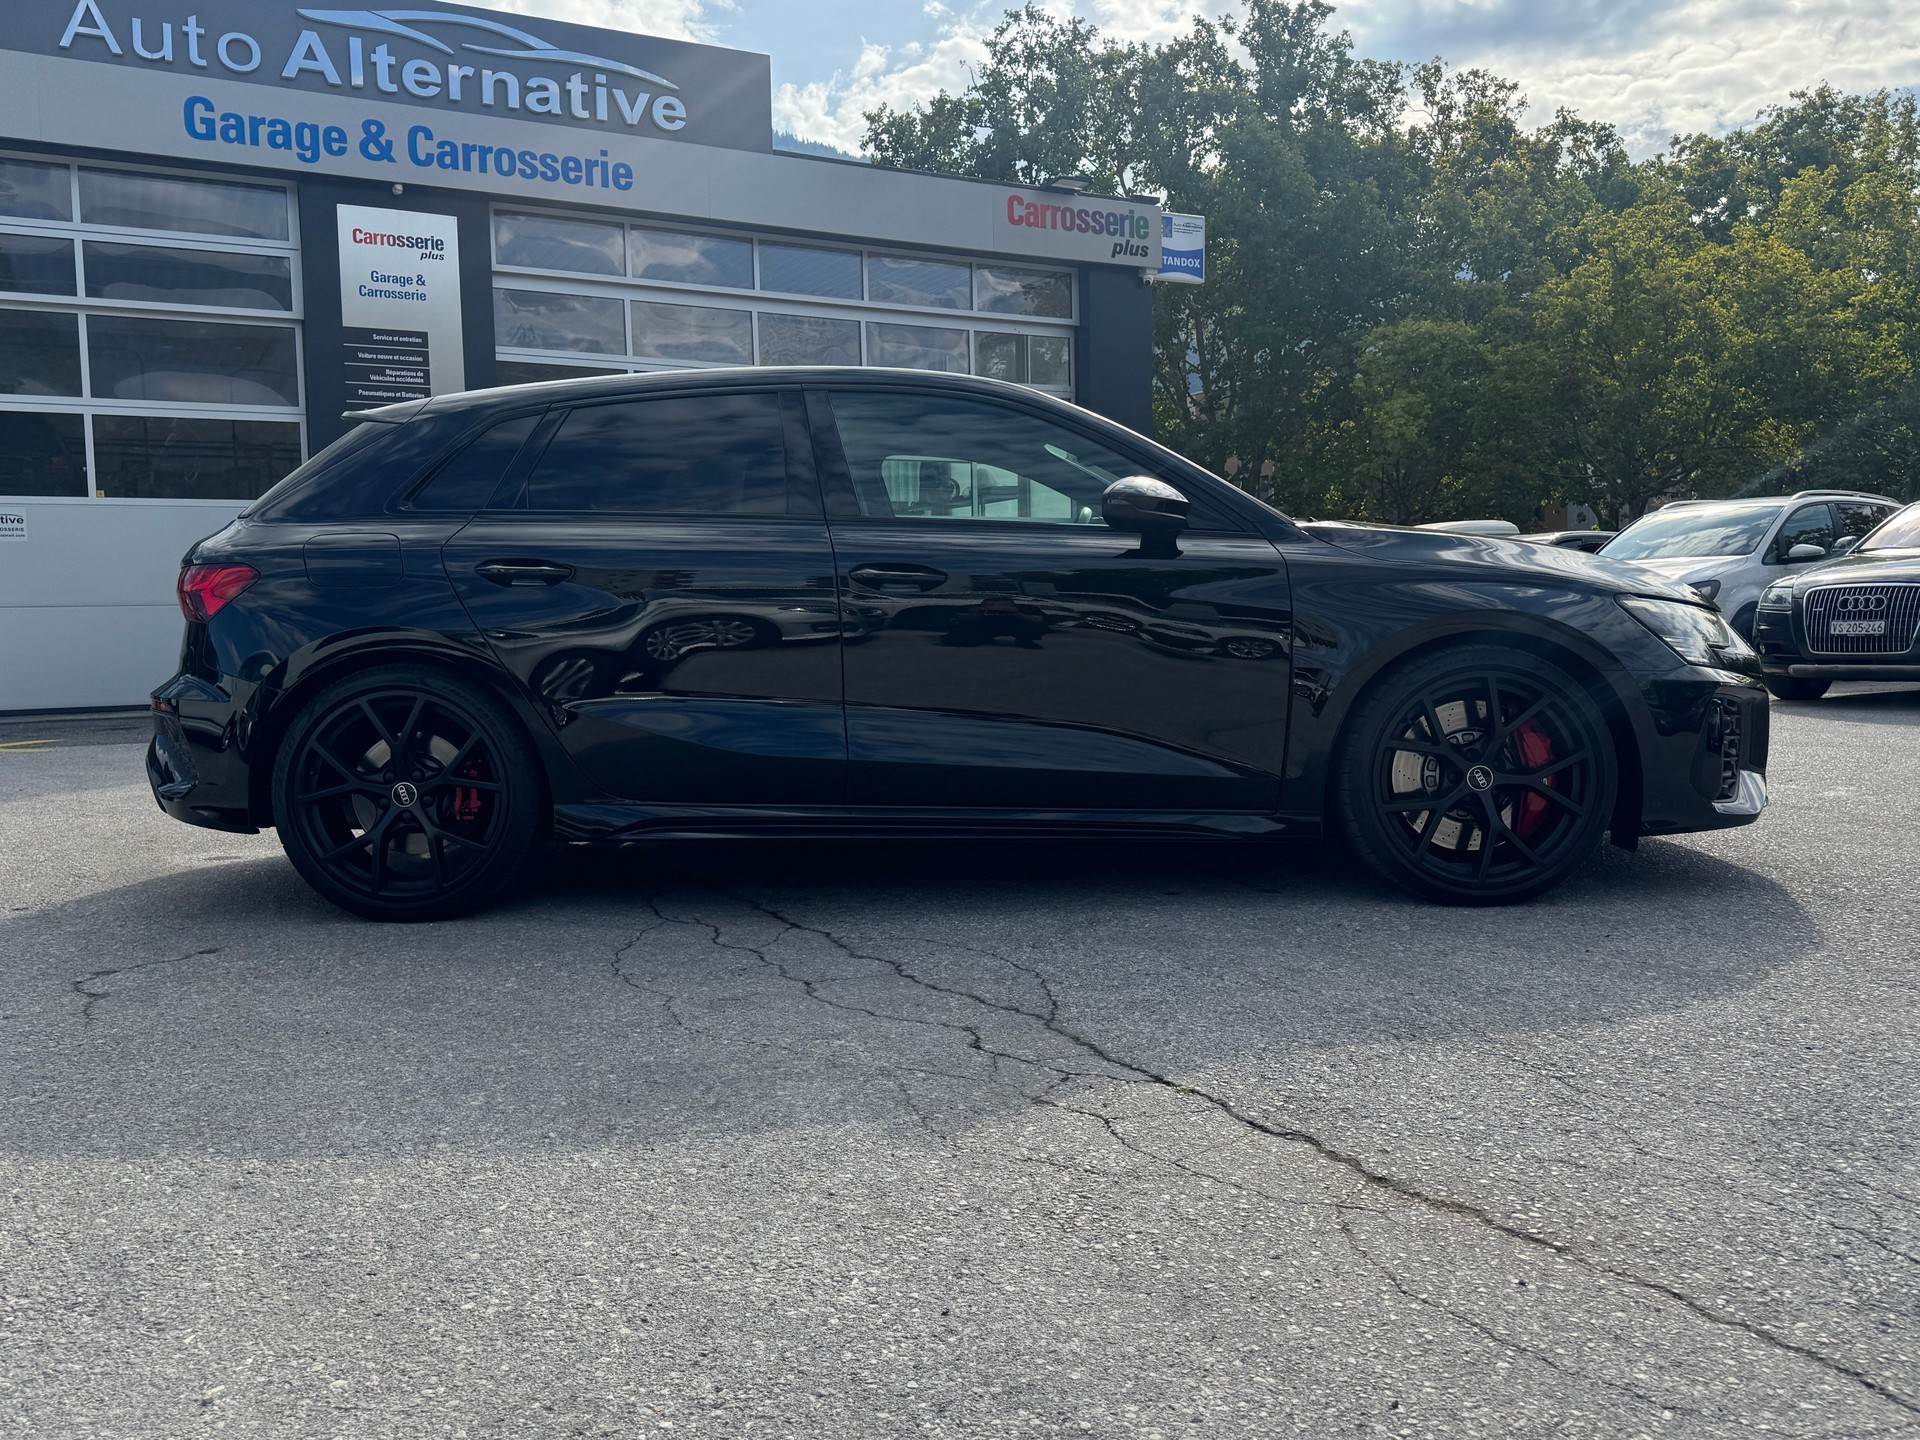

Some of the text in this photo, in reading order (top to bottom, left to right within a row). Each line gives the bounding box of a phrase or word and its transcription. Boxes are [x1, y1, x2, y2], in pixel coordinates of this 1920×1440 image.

[58, 0, 687, 131] Auto Alternative
[183, 95, 634, 191] Garage & Carrosserie
[1007, 194, 1150, 240] Carrosserie
[352, 228, 444, 251] Carrosserie
[420, 251, 445, 261] plus
[1111, 239, 1149, 259] plus
[1162, 255, 1201, 268] TANDOX
[371, 270, 426, 287] Garage &
[358, 284, 427, 301] Carrosserie
[372, 333, 392, 341] Service
[357, 351, 377, 359] Voiture
[358, 389, 395, 398] Pneumatiques
[401, 391, 425, 399] Batteries
